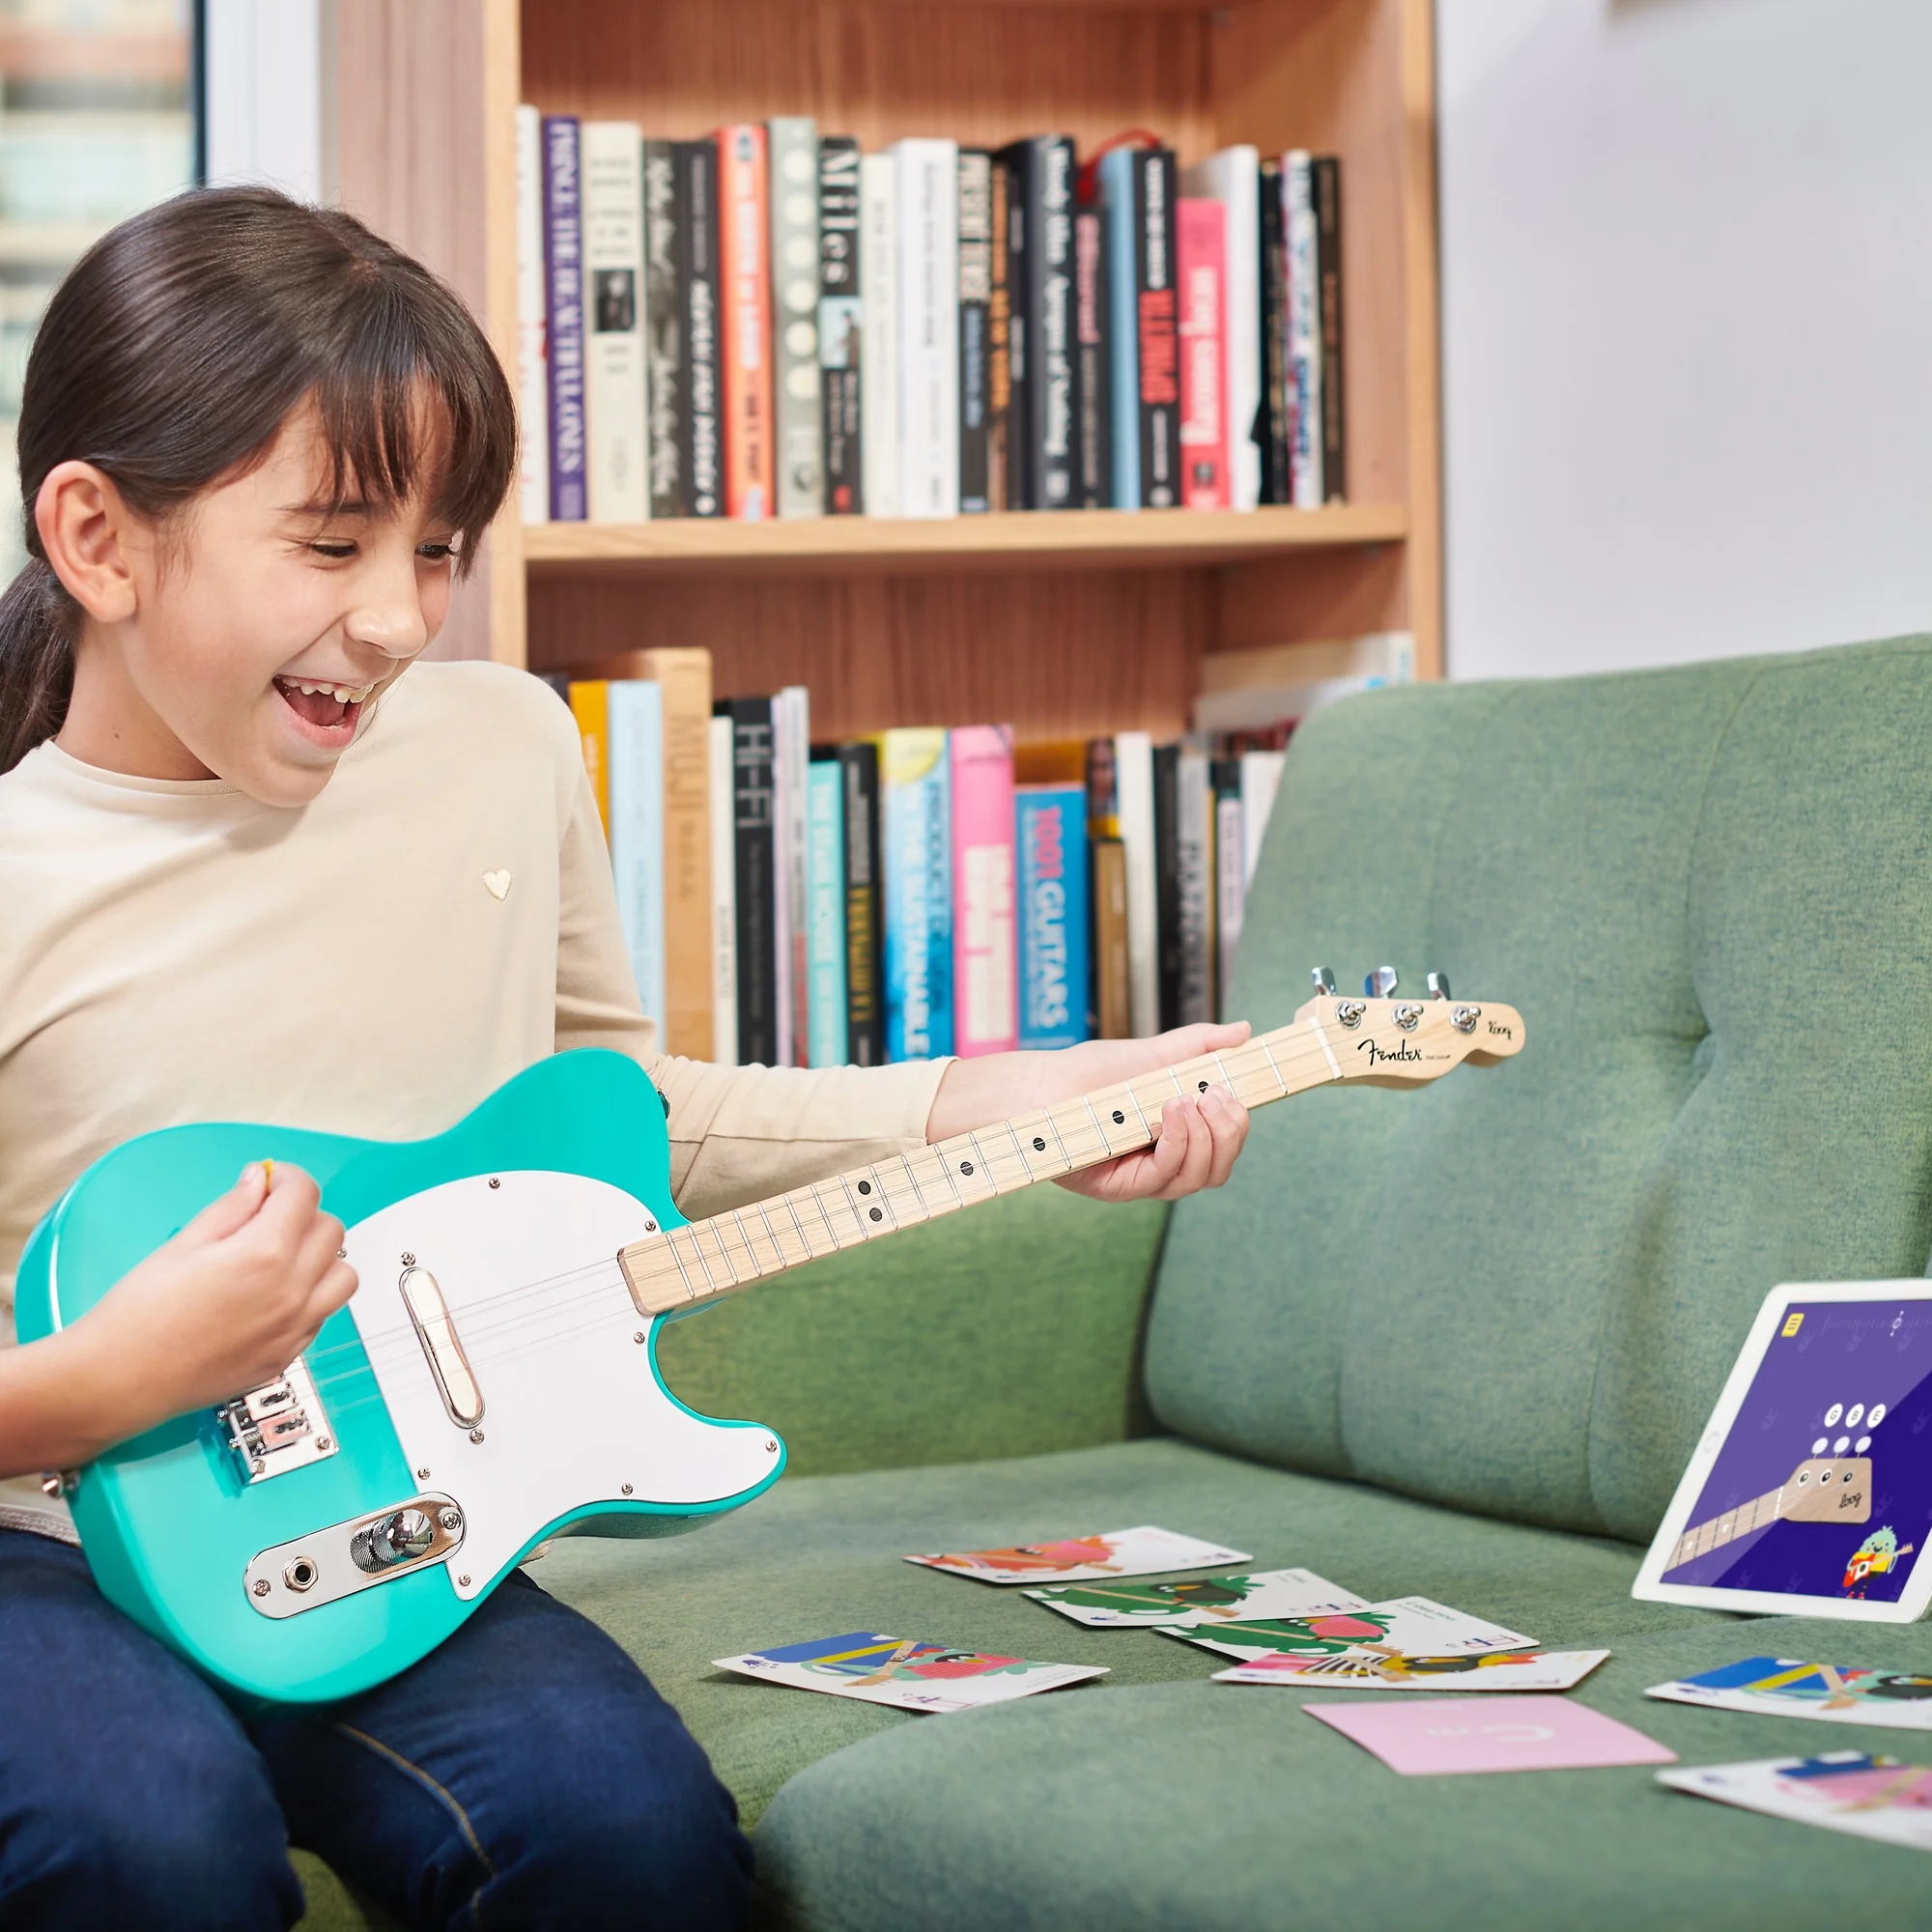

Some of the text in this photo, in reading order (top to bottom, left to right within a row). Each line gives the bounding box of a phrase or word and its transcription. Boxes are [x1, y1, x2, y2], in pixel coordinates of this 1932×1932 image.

[821, 147, 859, 285] Miles
[668, 713, 707, 811] MUJI
[1035, 806, 1067, 1029] 1001 GUITARS
[1357, 1038, 1422, 1066] Fender
[1838, 1492, 1861, 1508] loog
